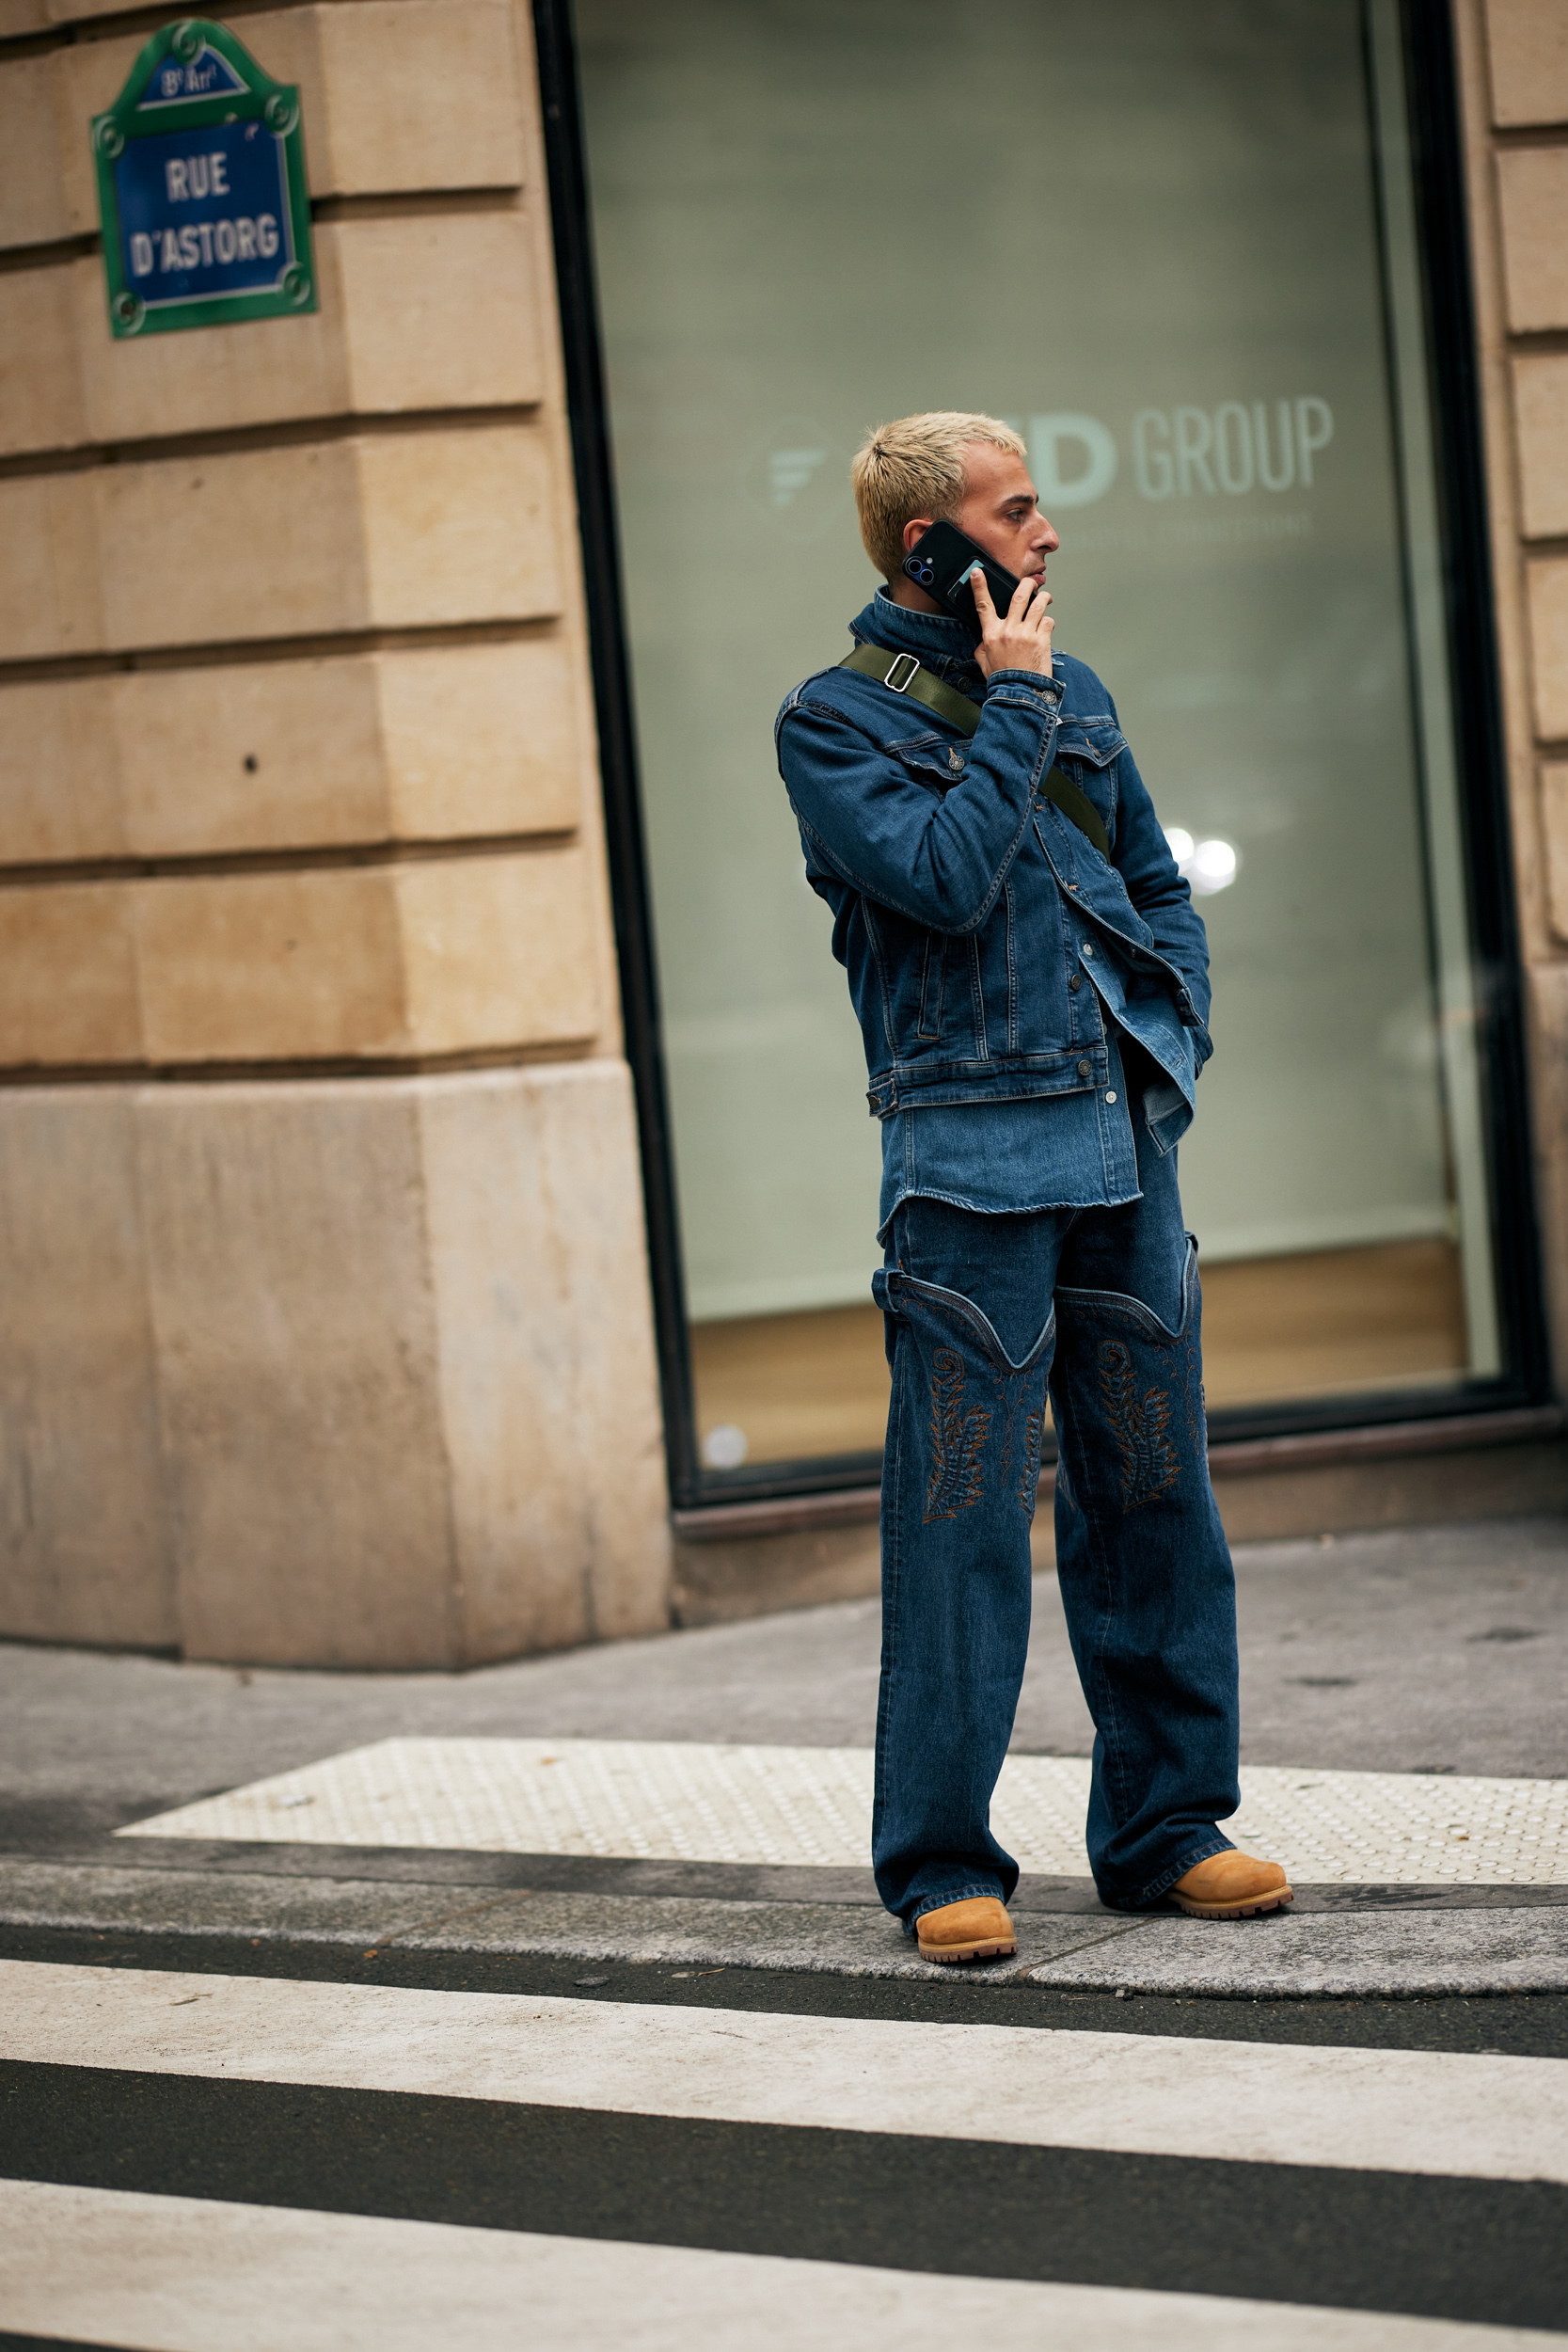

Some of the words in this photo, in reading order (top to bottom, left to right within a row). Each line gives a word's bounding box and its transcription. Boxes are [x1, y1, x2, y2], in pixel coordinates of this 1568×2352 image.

[165, 151, 230, 202] RUE
[131, 214, 279, 277] D'ASTORG
[1132, 395, 1335, 501] GROUP
